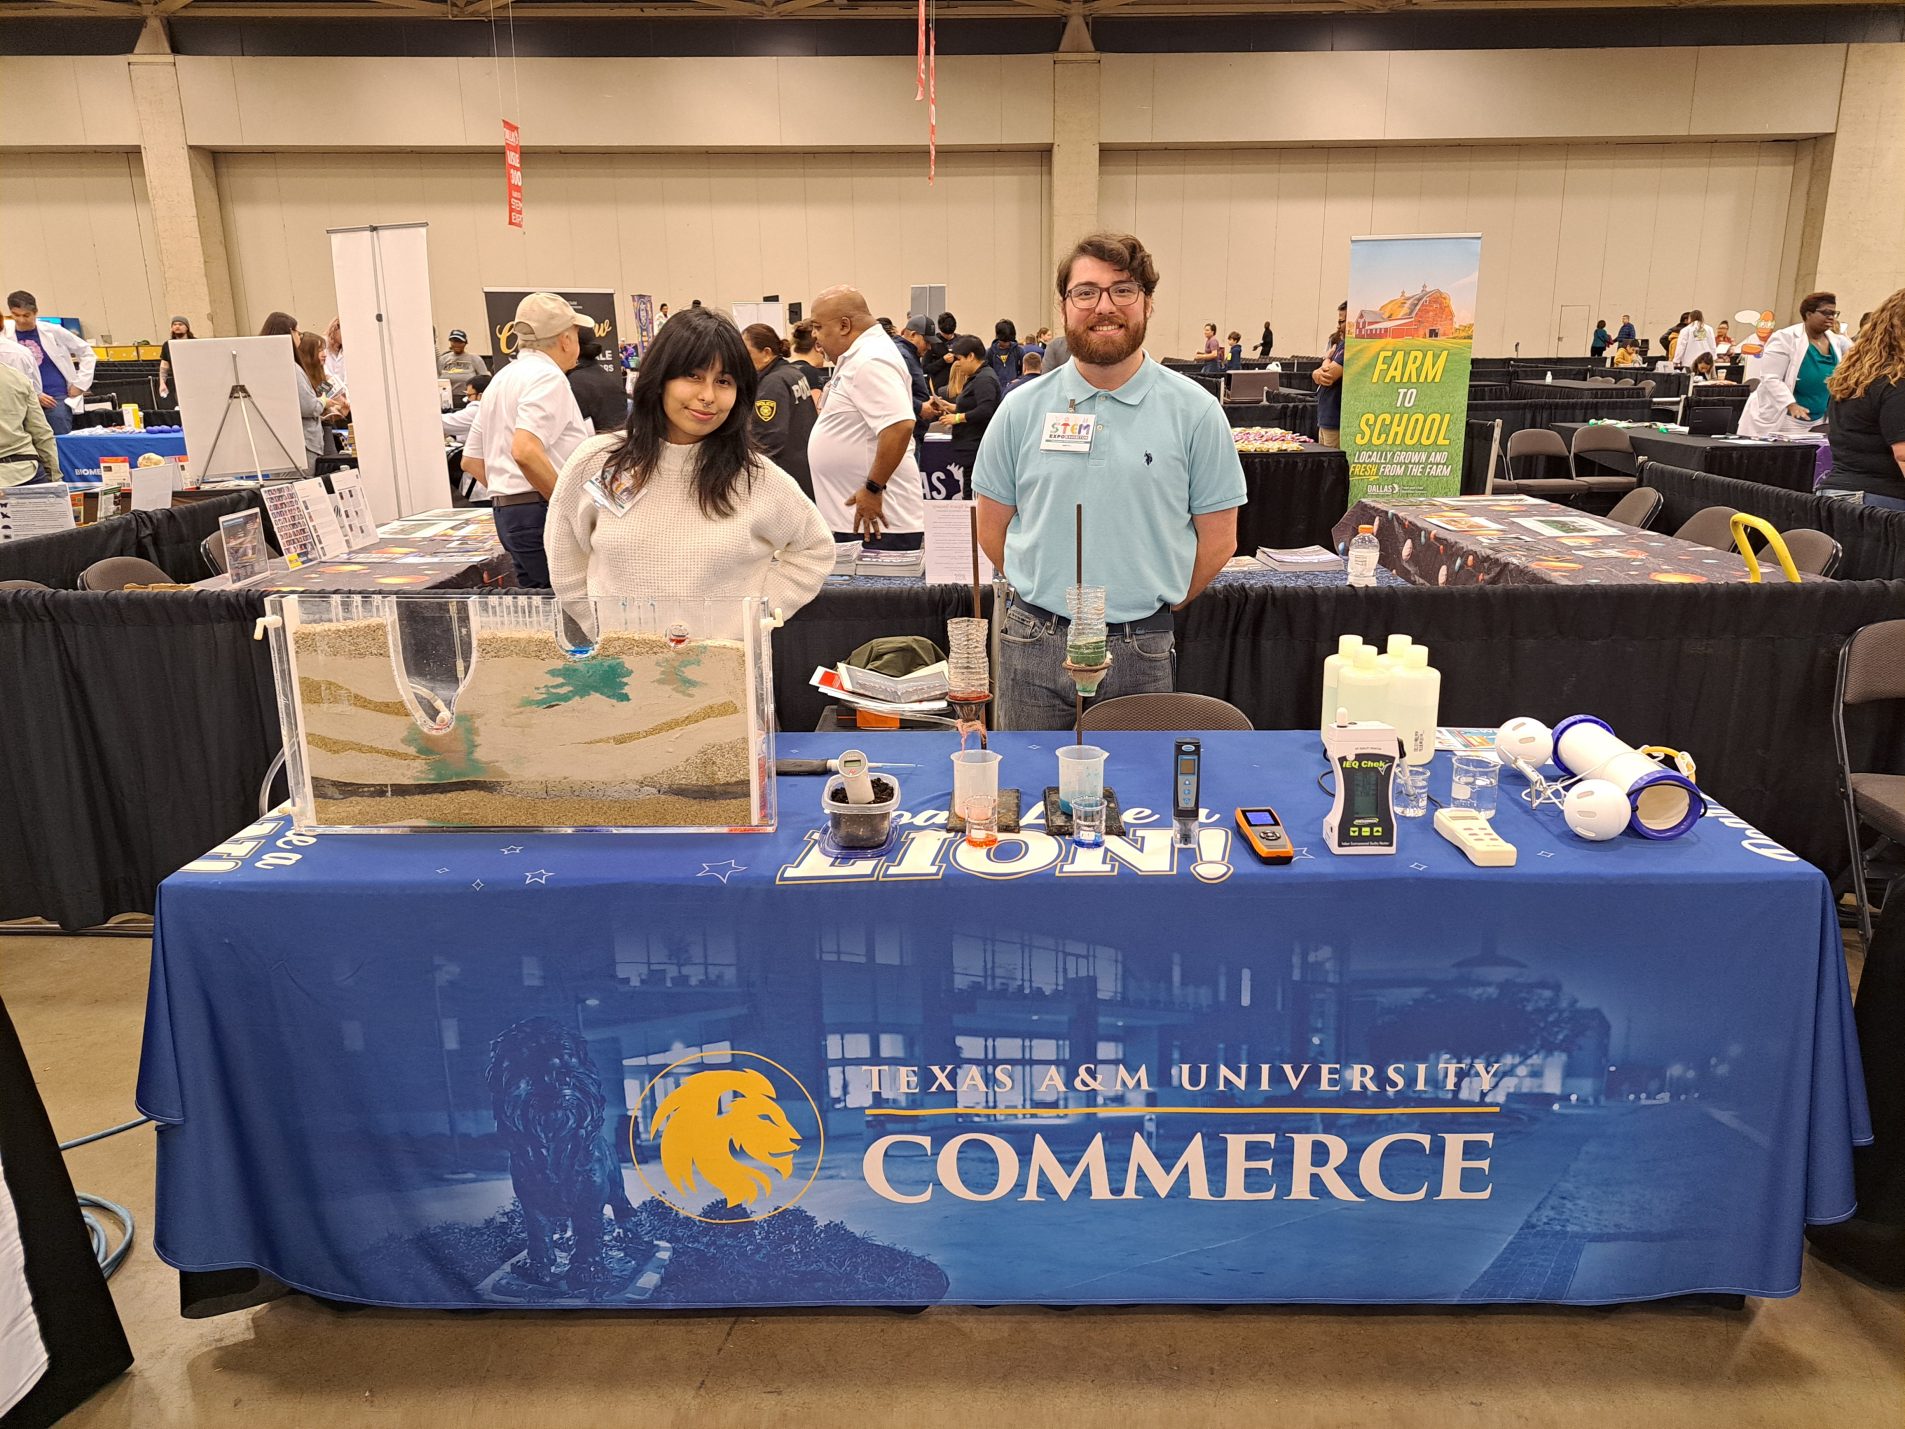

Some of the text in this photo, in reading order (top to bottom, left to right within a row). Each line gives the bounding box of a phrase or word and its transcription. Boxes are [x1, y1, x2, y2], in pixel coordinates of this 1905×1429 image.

[1371, 351, 1448, 383] FARM
[1396, 388, 1417, 408] TO
[1050, 423, 1091, 435] STEM
[1355, 413, 1451, 446] SCHOOL
[1354, 451, 1448, 463] LOCALLY GROWN AND
[1350, 464, 1452, 477] FRESH FROM THE FARM
[1367, 484, 1392, 493] DALLAS
[1342, 760, 1386, 769] IEQ Chek
[776, 827, 1234, 884] LION!
[862, 1063, 1503, 1094] TEXAS A&M UNIVERSITY
[862, 1131, 1495, 1204] COMMERCE
